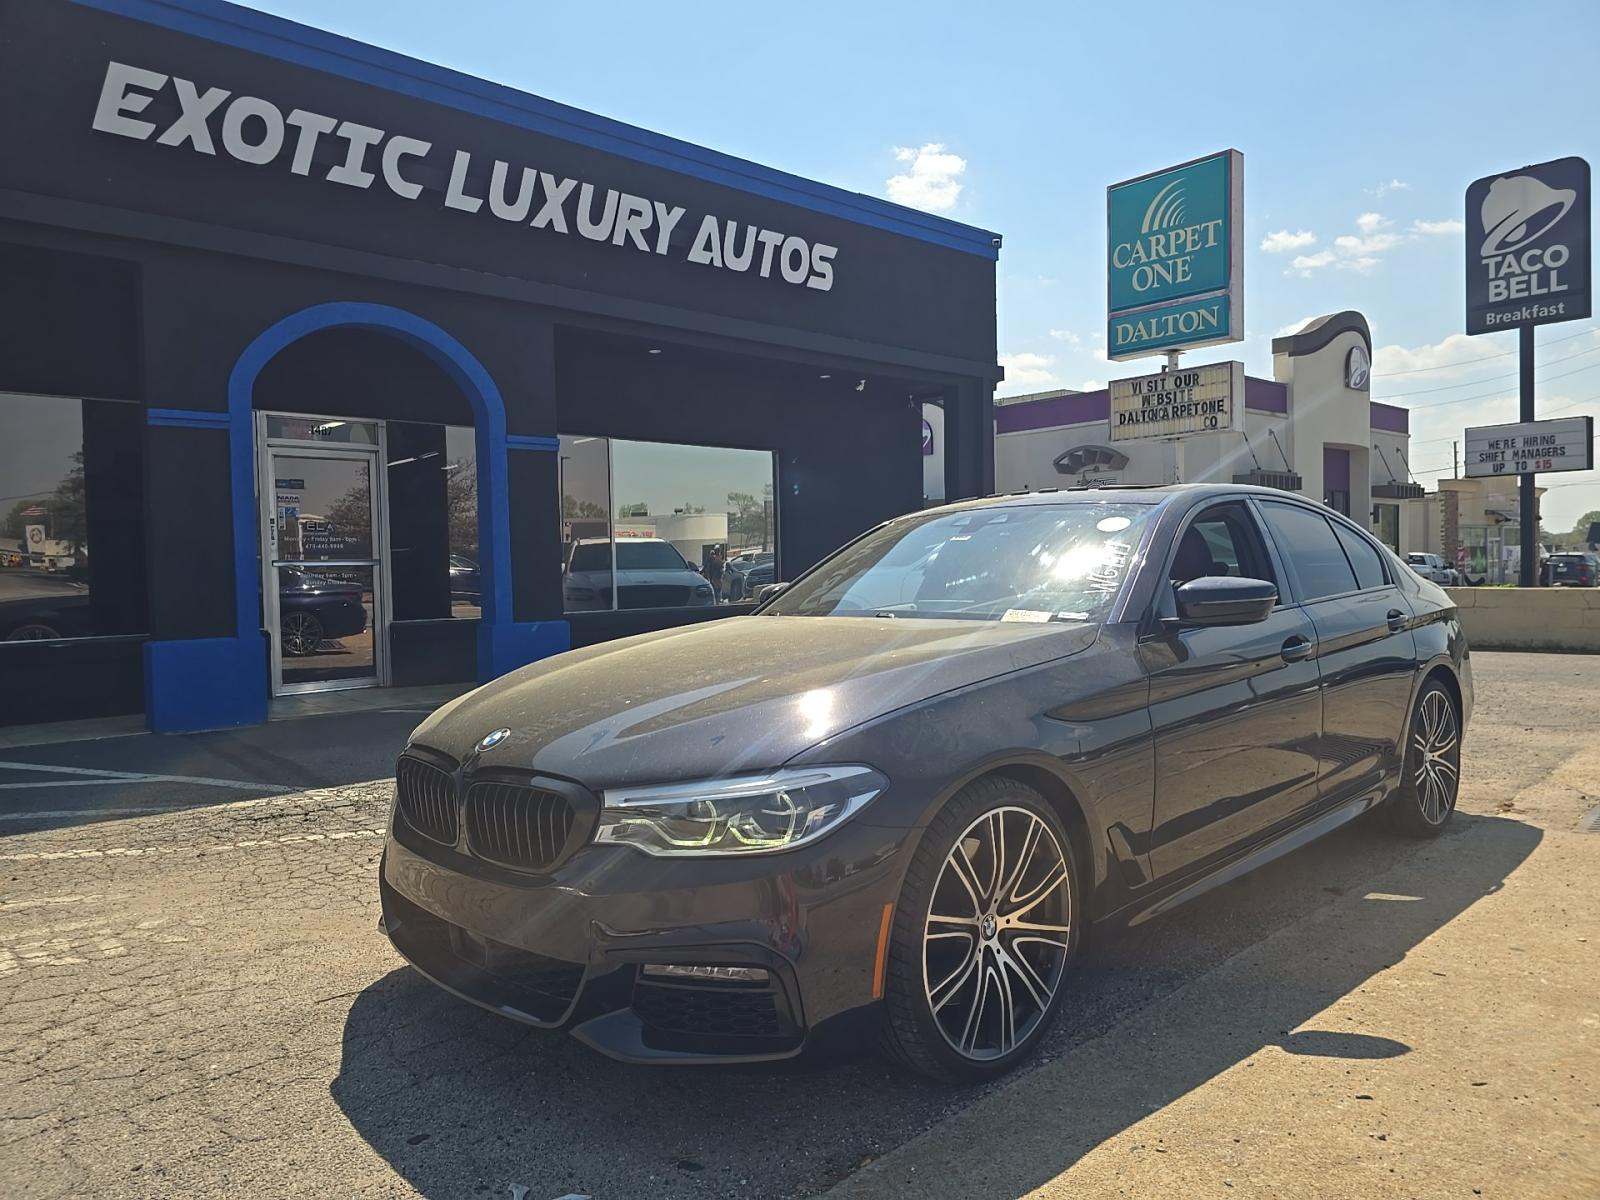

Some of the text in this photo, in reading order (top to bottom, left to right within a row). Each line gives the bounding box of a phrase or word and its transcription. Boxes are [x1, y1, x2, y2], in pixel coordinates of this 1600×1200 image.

[92, 61, 839, 292] EXOTIC LUXURY AUTOS
[1112, 219, 1223, 269] CARPET
[1131, 255, 1193, 292] ONE
[1481, 244, 1570, 279] TACO
[1488, 269, 1569, 303] BELL
[1115, 305, 1220, 346] DALTON
[1485, 302, 1566, 325] Breakfast
[1131, 373, 1200, 395] VISIT OUR
[1141, 388, 1193, 408] WEBSITE
[1479, 446, 1566, 463] SHIFT MANAGERS
[1522, 434, 1556, 447] HIRING
[1492, 463, 1506, 473] UP
[1514, 461, 1528, 471] TO
